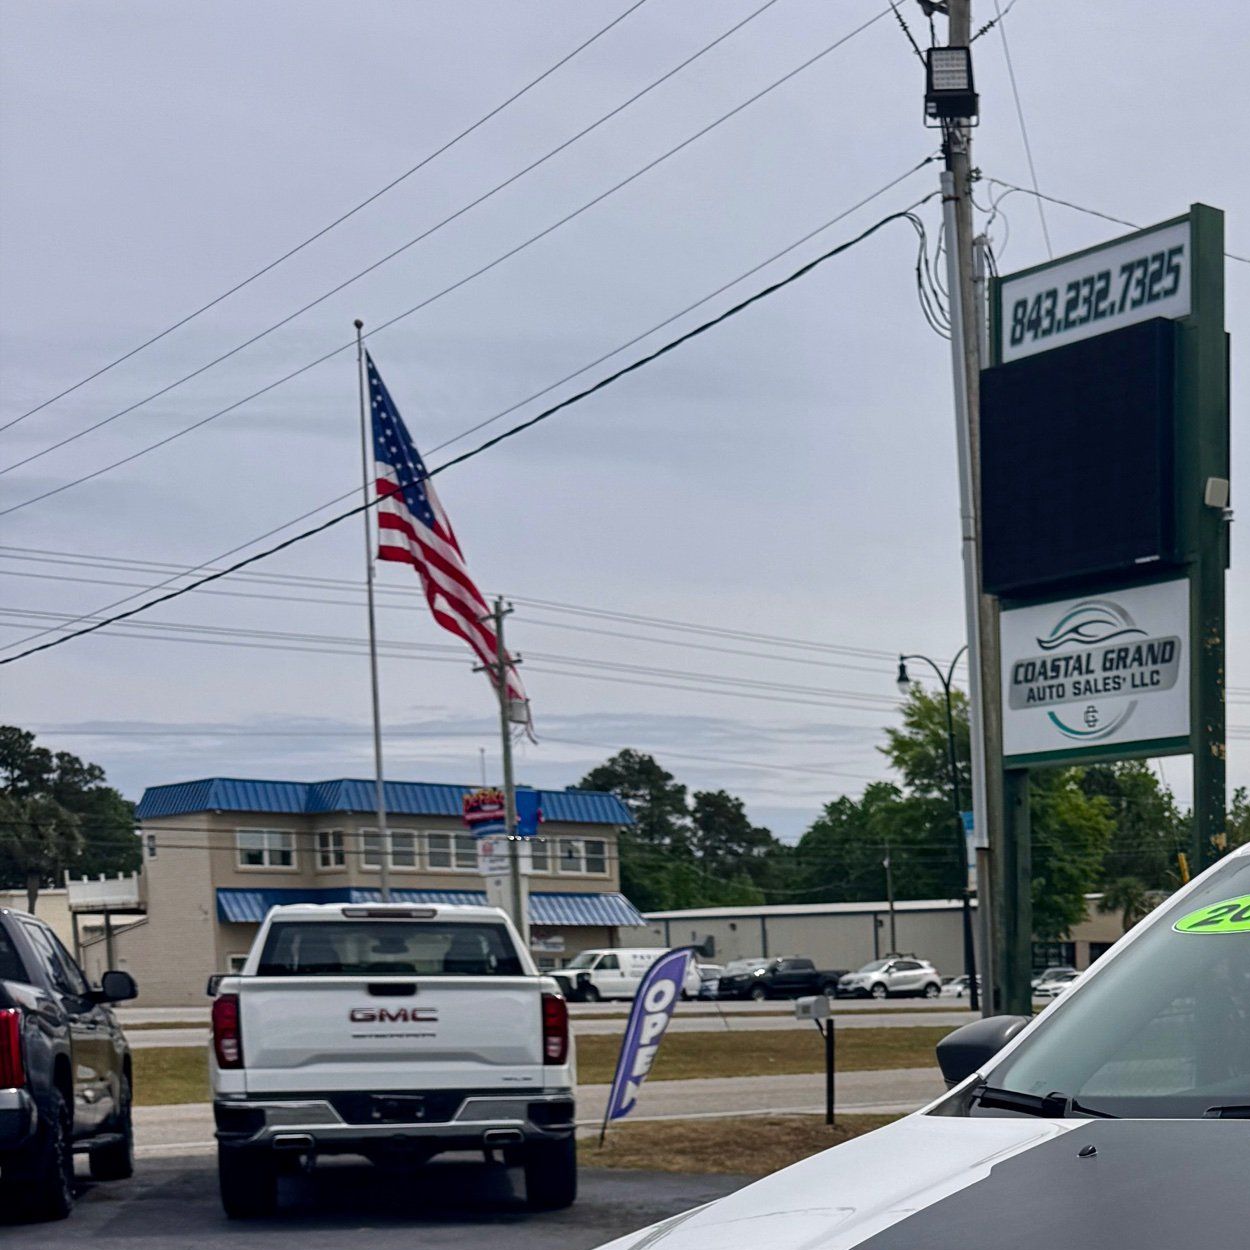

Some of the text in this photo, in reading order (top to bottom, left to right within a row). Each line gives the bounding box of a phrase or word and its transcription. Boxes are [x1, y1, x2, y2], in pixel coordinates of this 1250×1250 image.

[1010, 243, 1185, 347] 843.232.7325
[1013, 640, 1175, 685] COASTAL GRAND
[1026, 683, 1066, 703] AUTO
[1131, 669, 1160, 688] LLC
[349, 1008, 439, 1023] GMC
